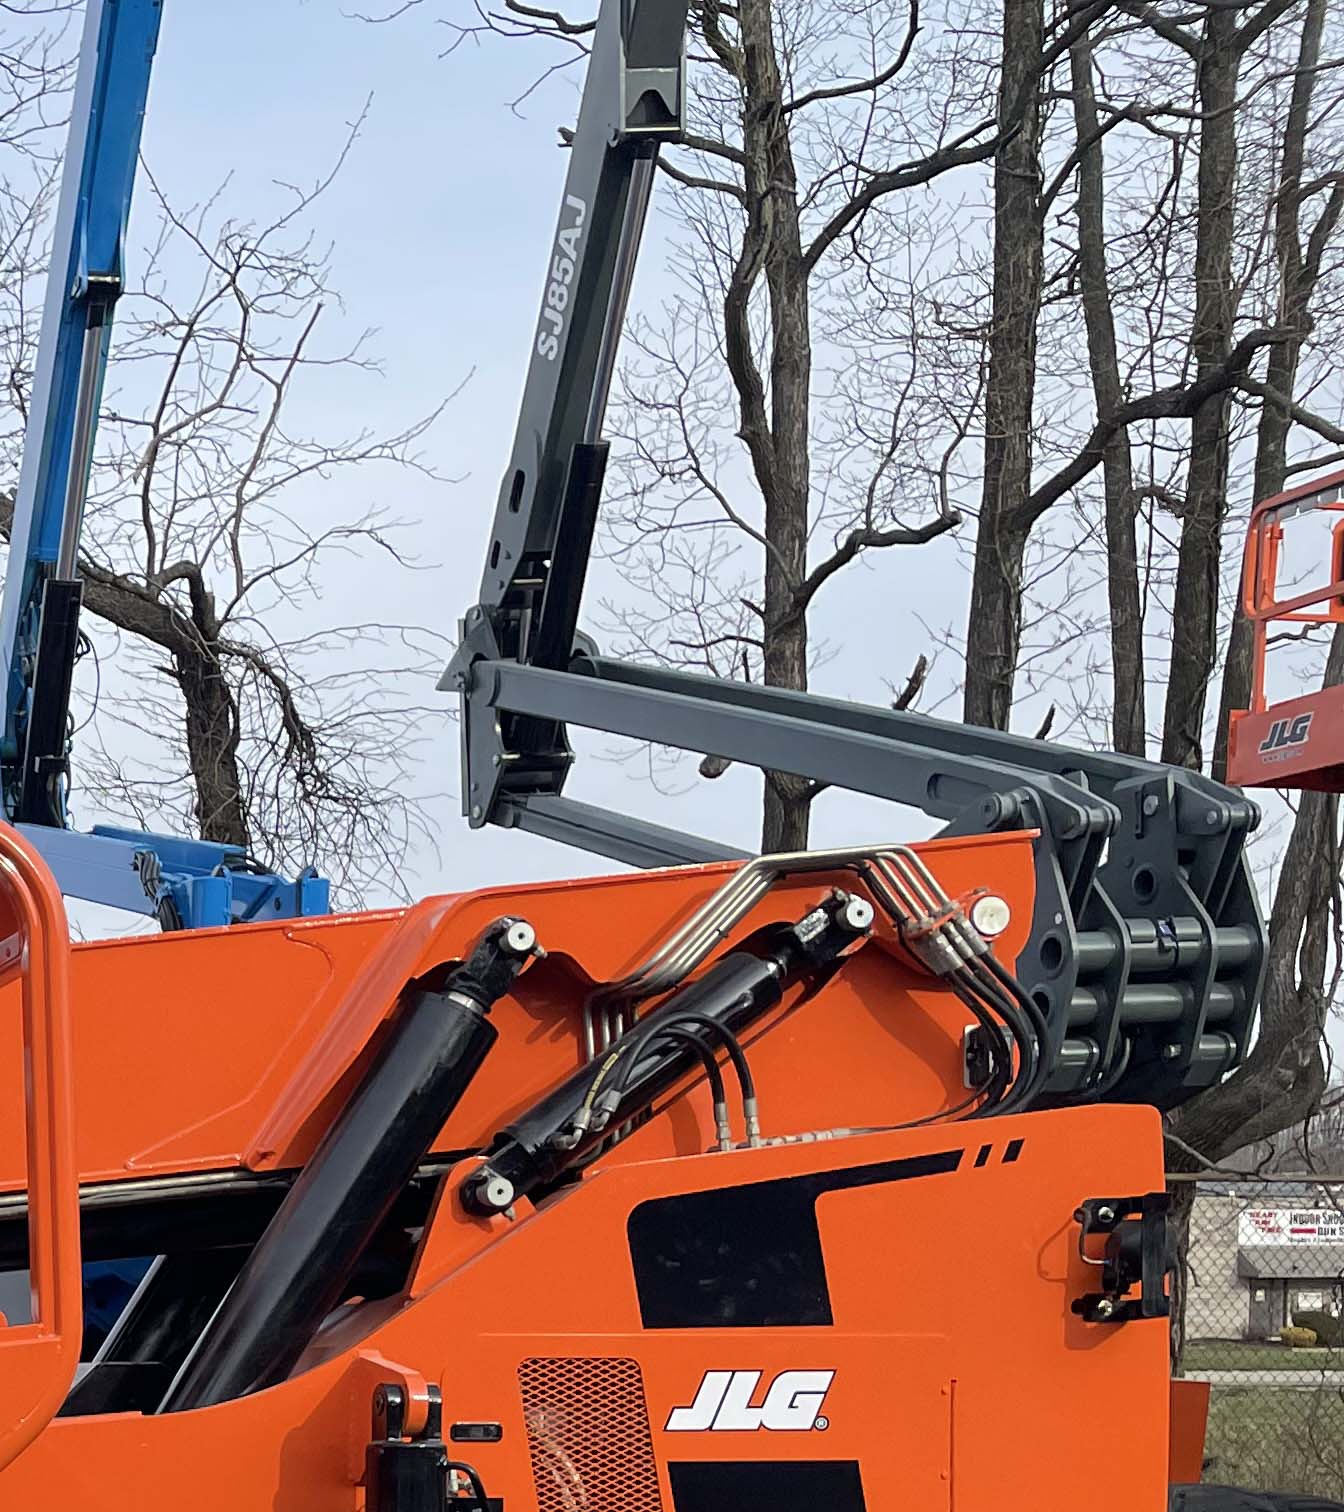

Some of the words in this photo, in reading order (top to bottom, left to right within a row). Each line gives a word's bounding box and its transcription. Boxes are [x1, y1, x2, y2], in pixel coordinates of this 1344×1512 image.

[537, 194, 586, 361] SJ85AJ
[1258, 712, 1314, 754] JLG
[663, 1369, 837, 1432] JLG
